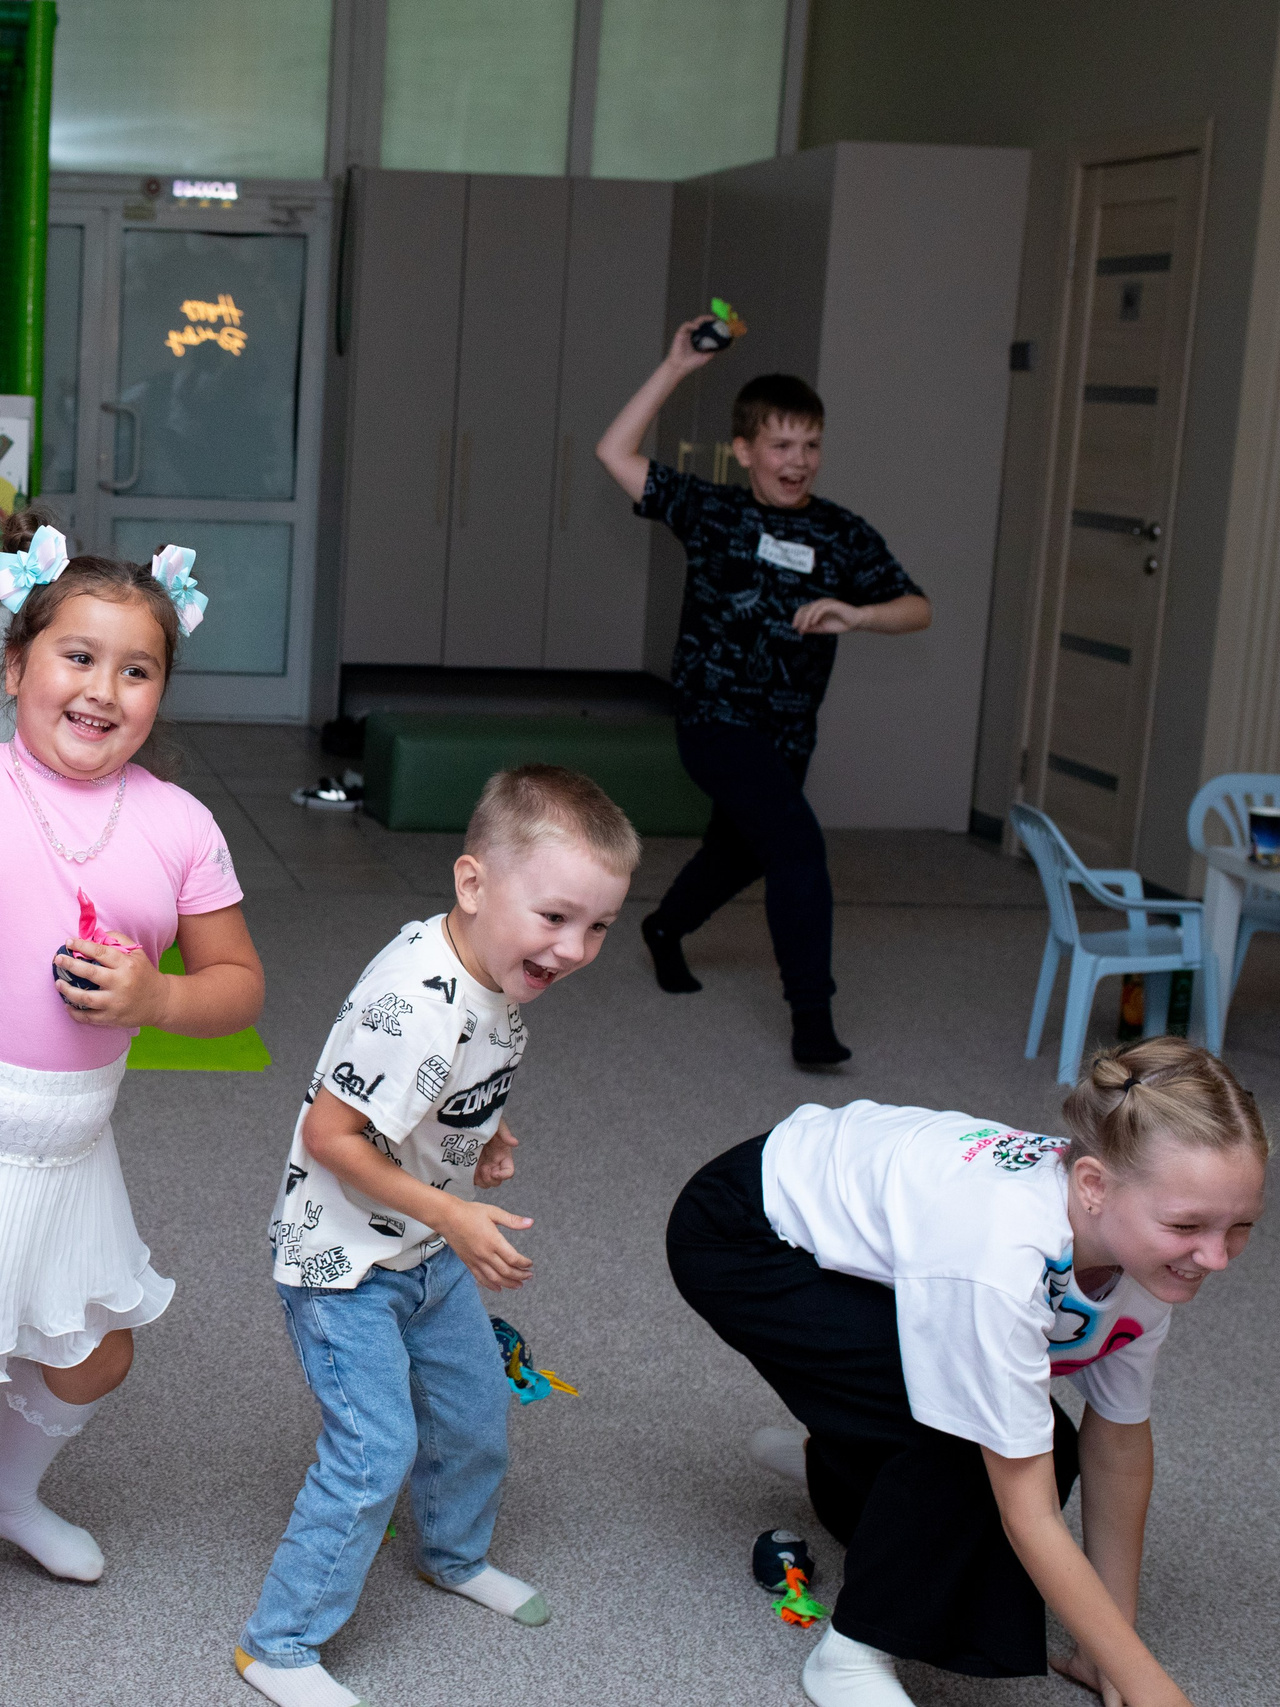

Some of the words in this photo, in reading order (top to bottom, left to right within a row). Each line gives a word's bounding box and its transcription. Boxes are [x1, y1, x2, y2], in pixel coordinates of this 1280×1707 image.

[441, 1133, 485, 1152] PLA
[279, 1222, 304, 1246] PLA
[301, 1246, 347, 1274] AME
